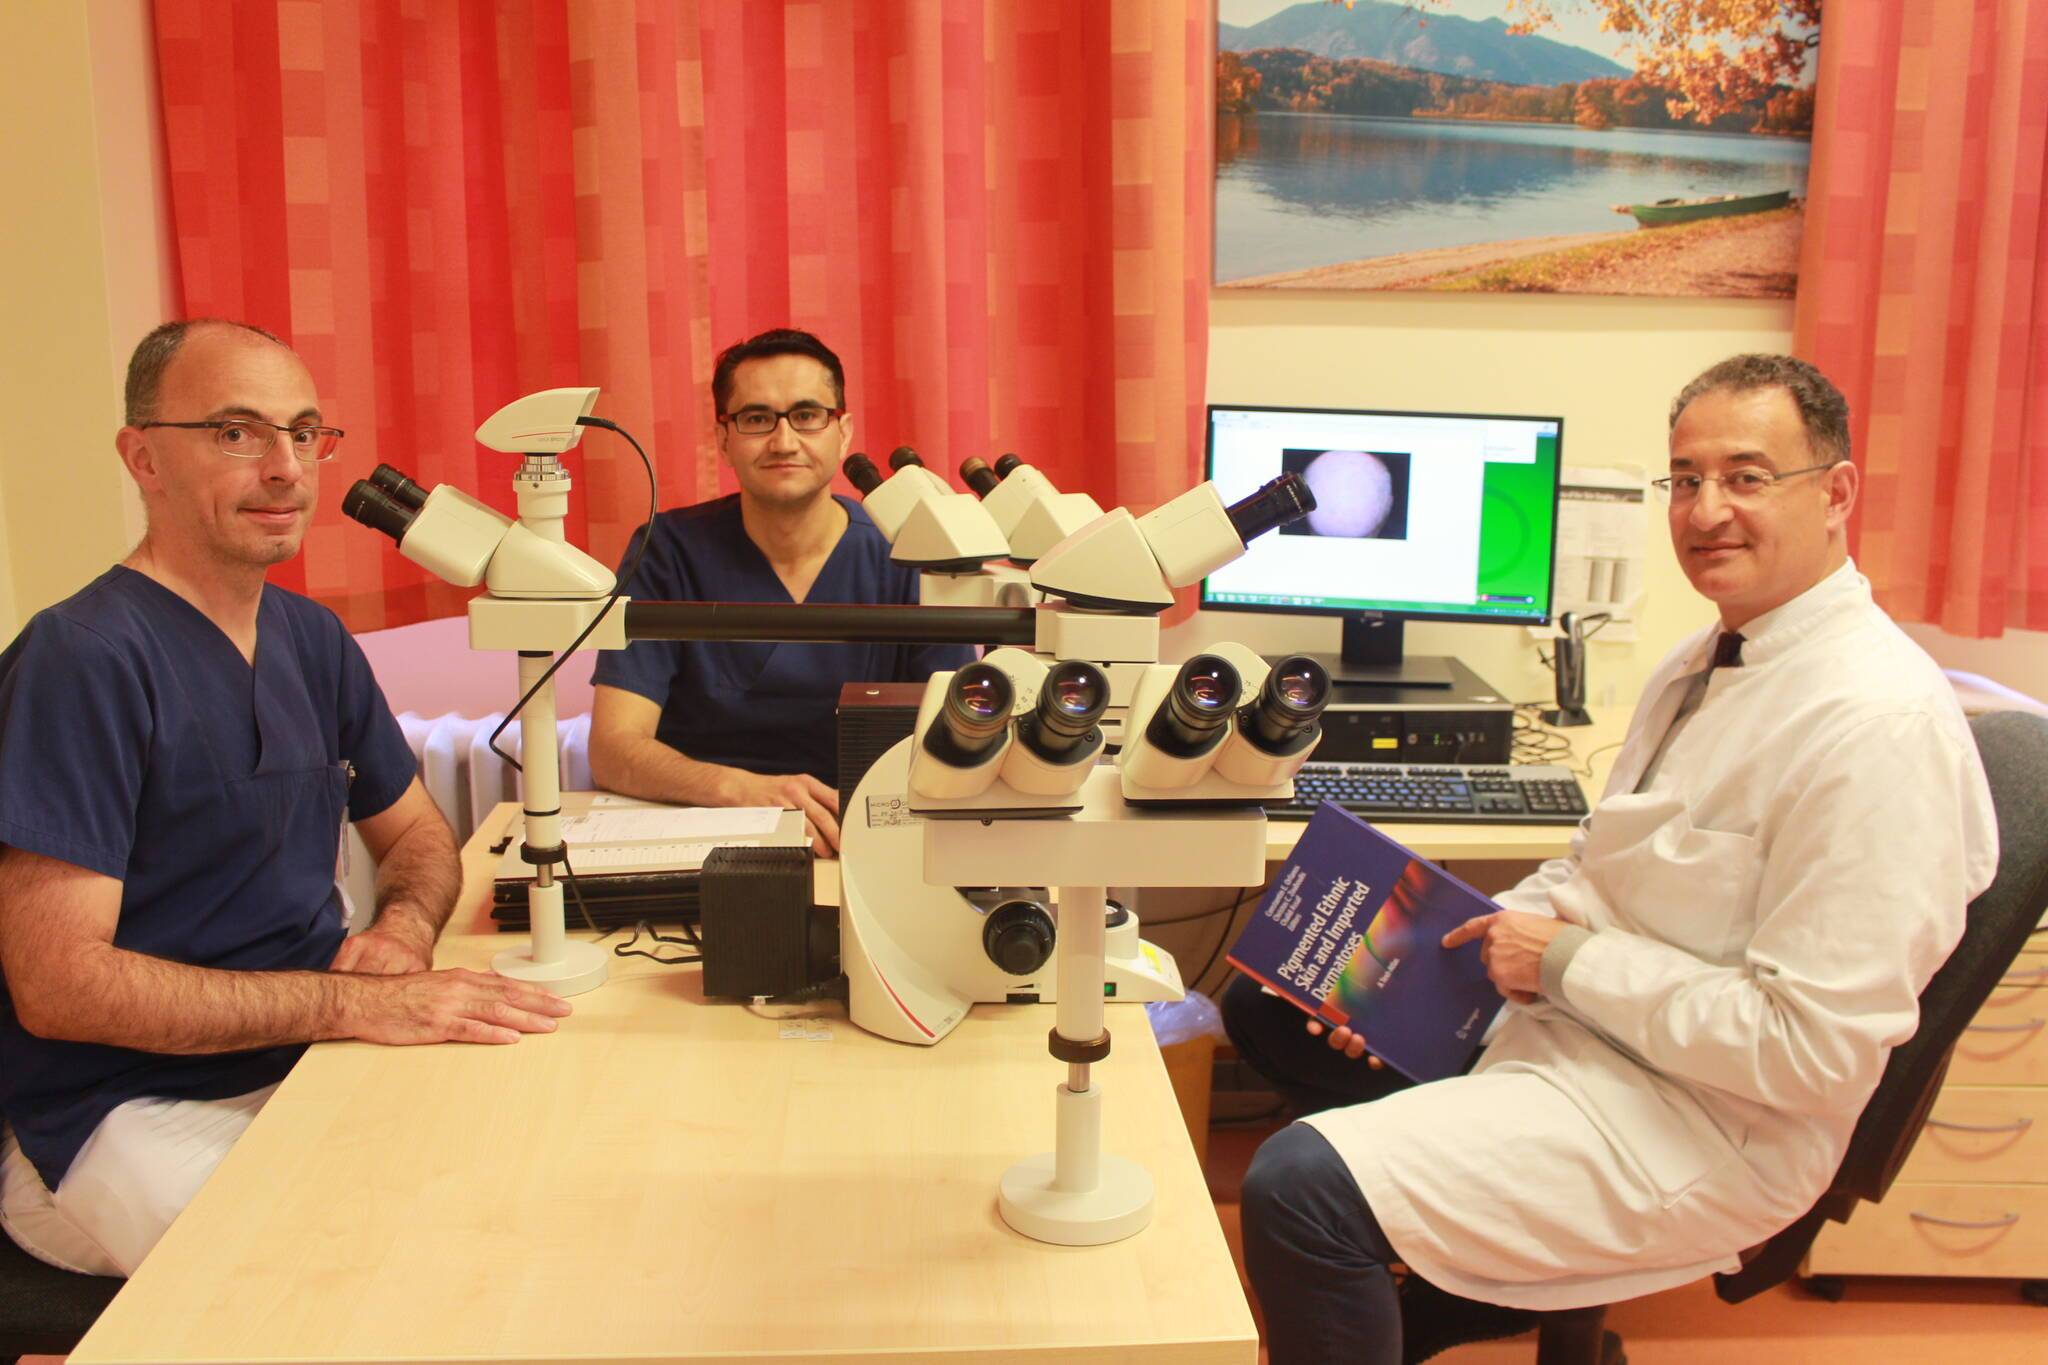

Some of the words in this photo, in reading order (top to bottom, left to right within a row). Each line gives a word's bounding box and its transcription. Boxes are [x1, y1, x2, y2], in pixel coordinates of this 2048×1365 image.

[1277, 912, 1326, 981] Pigmented
[1316, 876, 1351, 917] Ethnic
[1294, 963, 1322, 991] Skin
[1314, 936, 1336, 965] and
[1325, 880, 1371, 941] Imported
[1311, 931, 1363, 1001] Dermatoses
